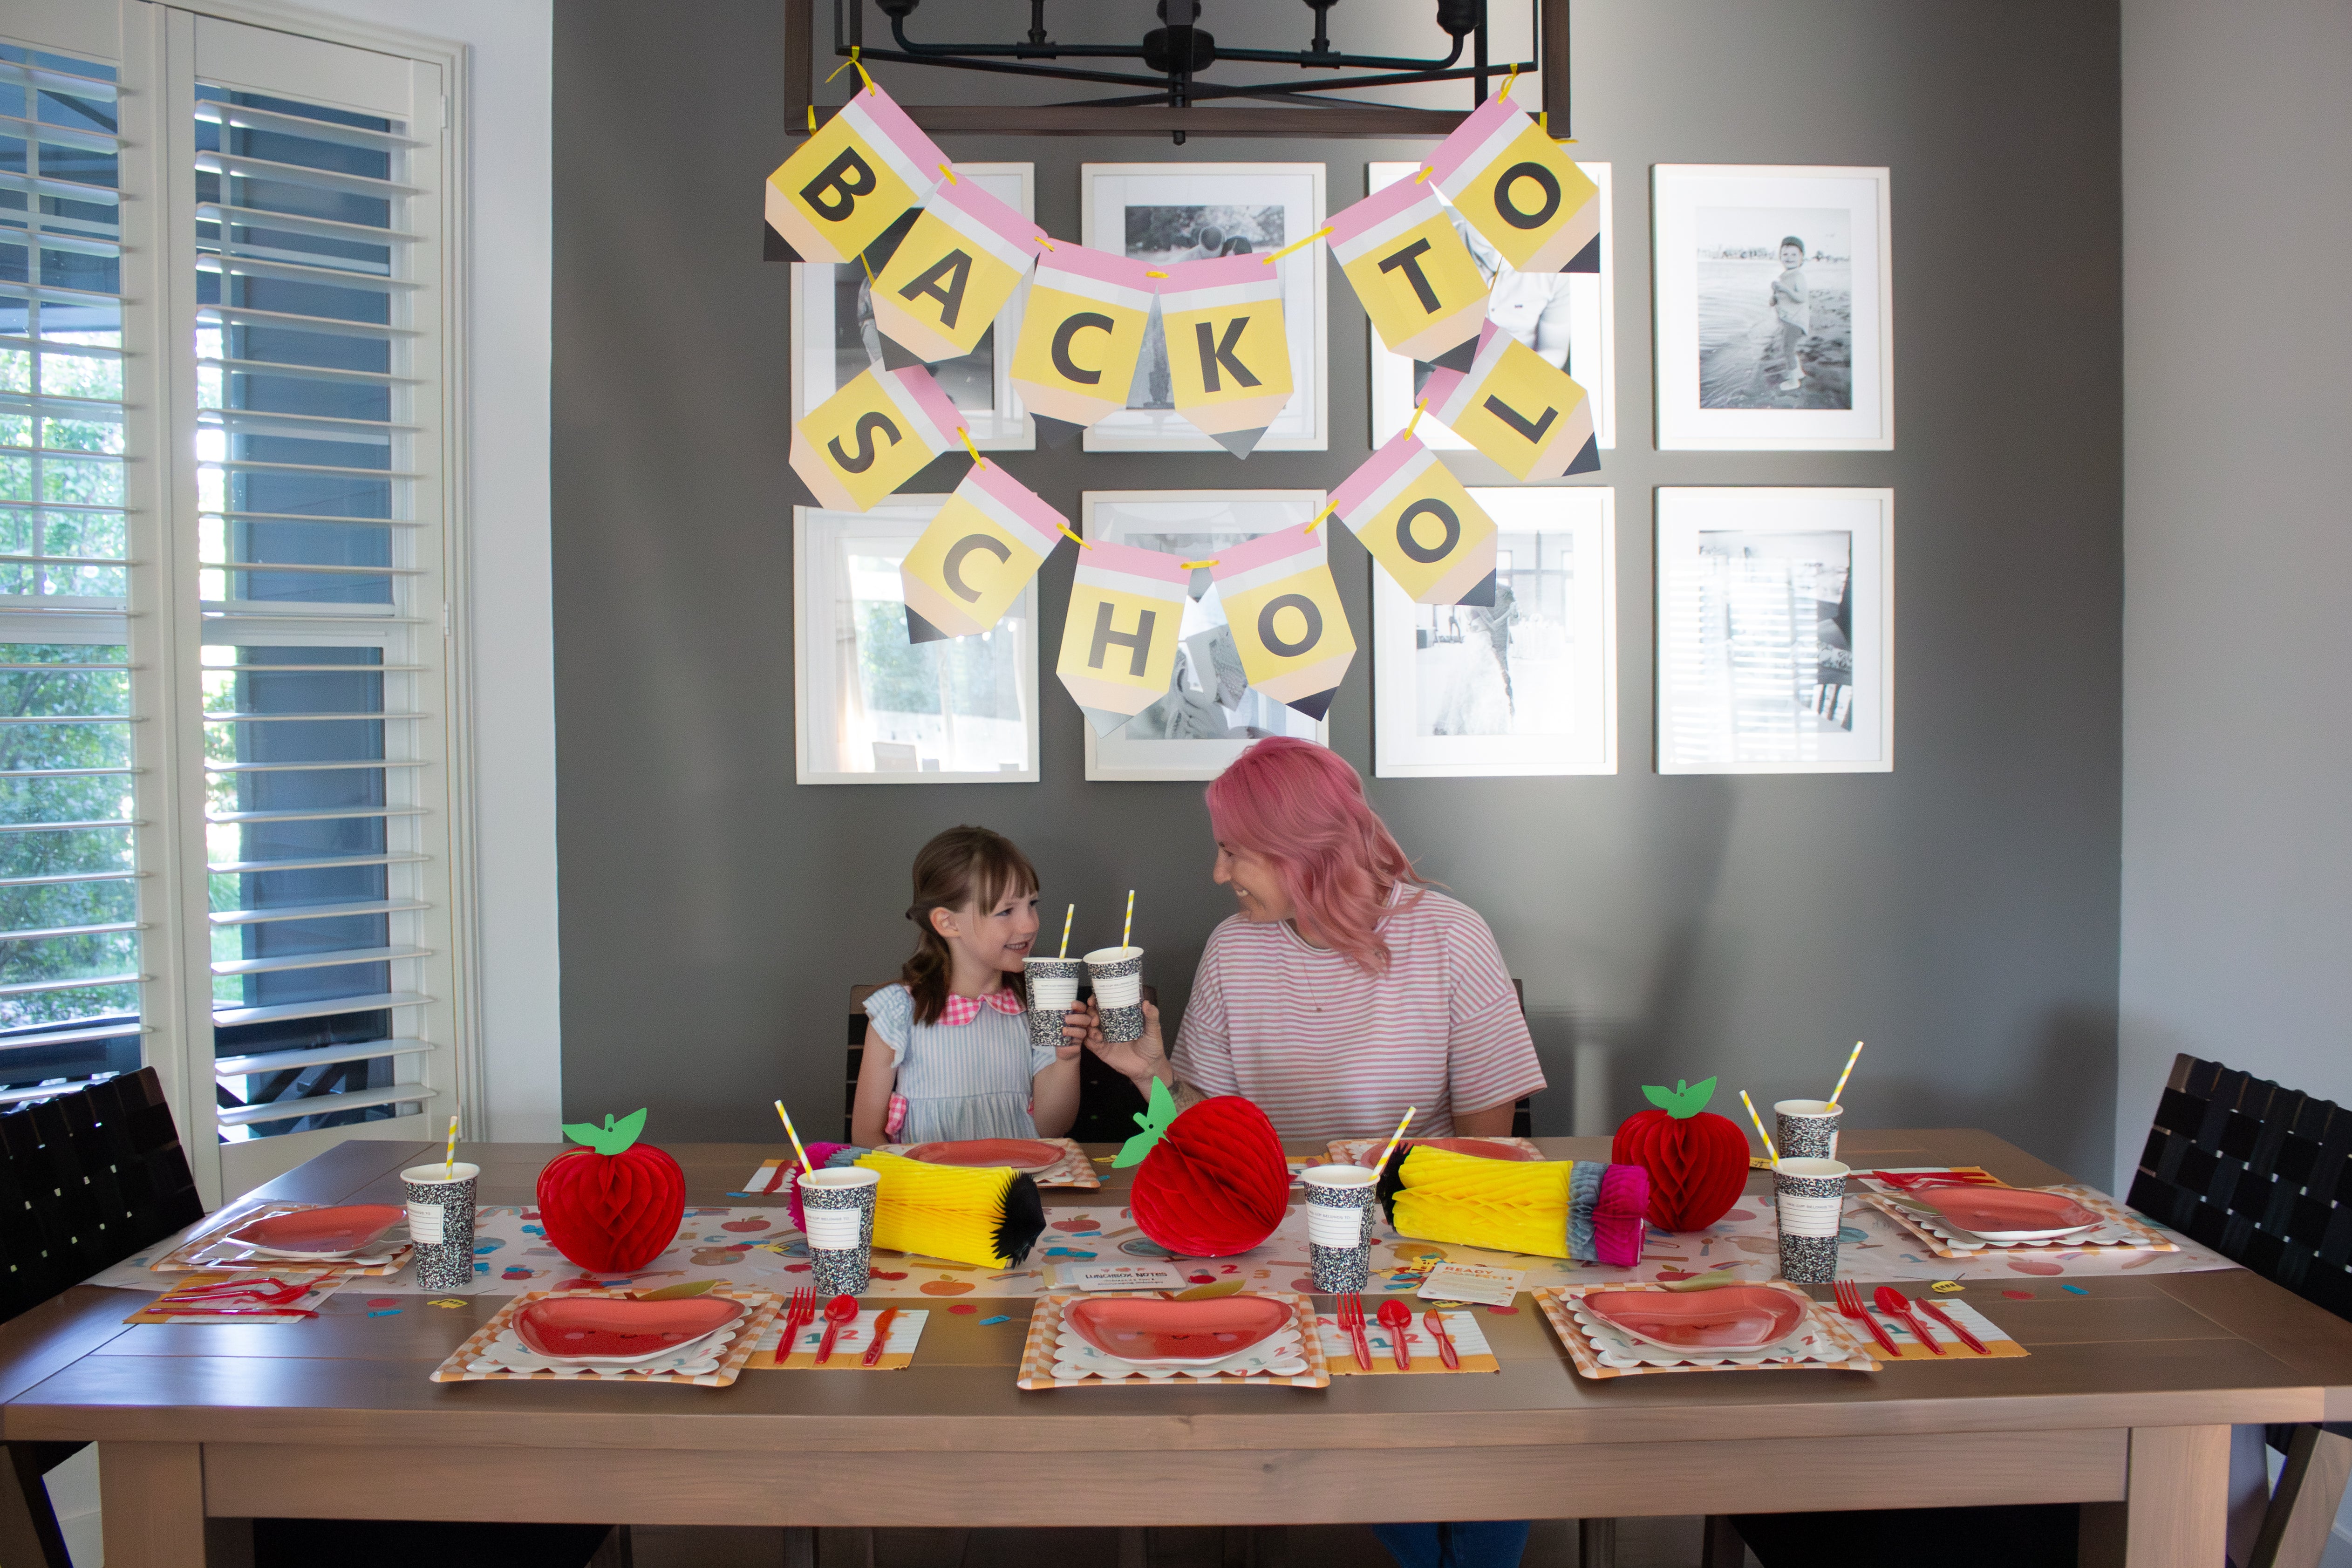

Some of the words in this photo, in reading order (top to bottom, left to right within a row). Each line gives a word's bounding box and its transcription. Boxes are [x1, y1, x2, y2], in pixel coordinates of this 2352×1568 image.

[799, 146, 1262, 393] BACK
[1377, 162, 1561, 314] TO
[827, 394, 1559, 677] SCHOOL
[1220, 1264, 1241, 1274] 2
[839, 1330, 859, 1340] 2
